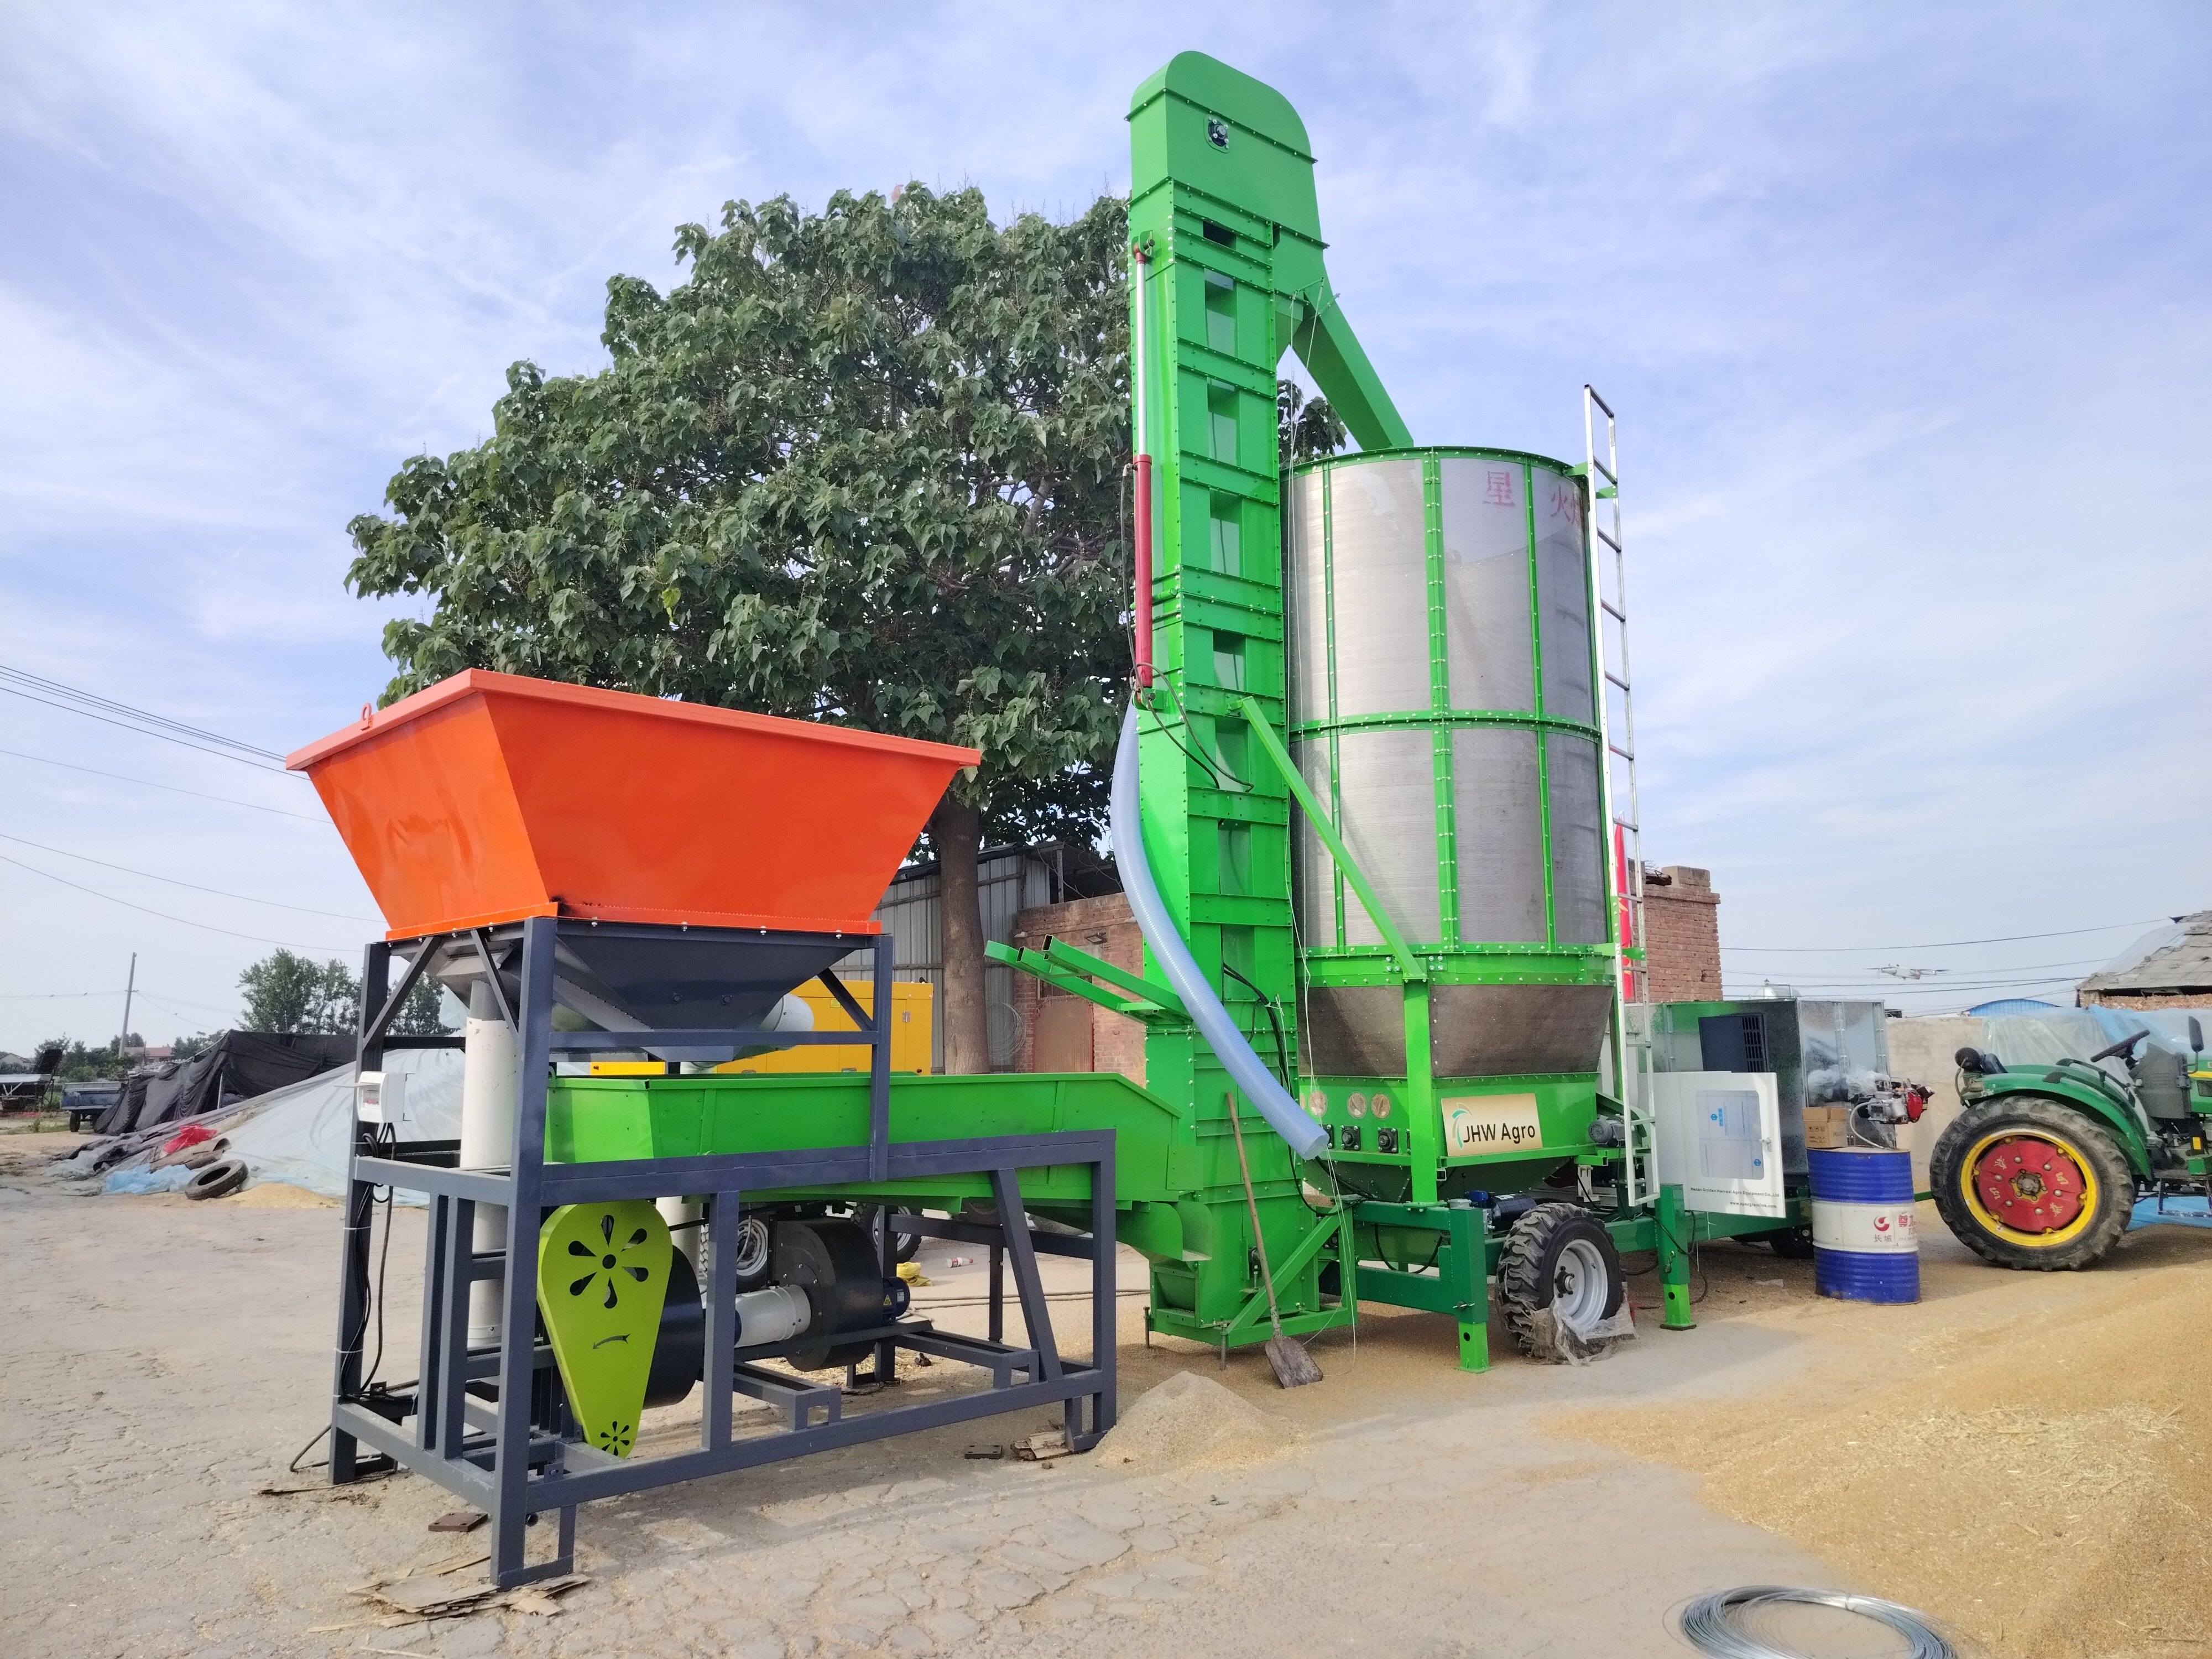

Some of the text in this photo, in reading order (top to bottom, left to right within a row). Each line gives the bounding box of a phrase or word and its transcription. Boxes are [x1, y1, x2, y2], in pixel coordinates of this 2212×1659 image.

[1463, 1123, 1535, 1144] JHW Agro
[1874, 1234, 1892, 1243] 长城
